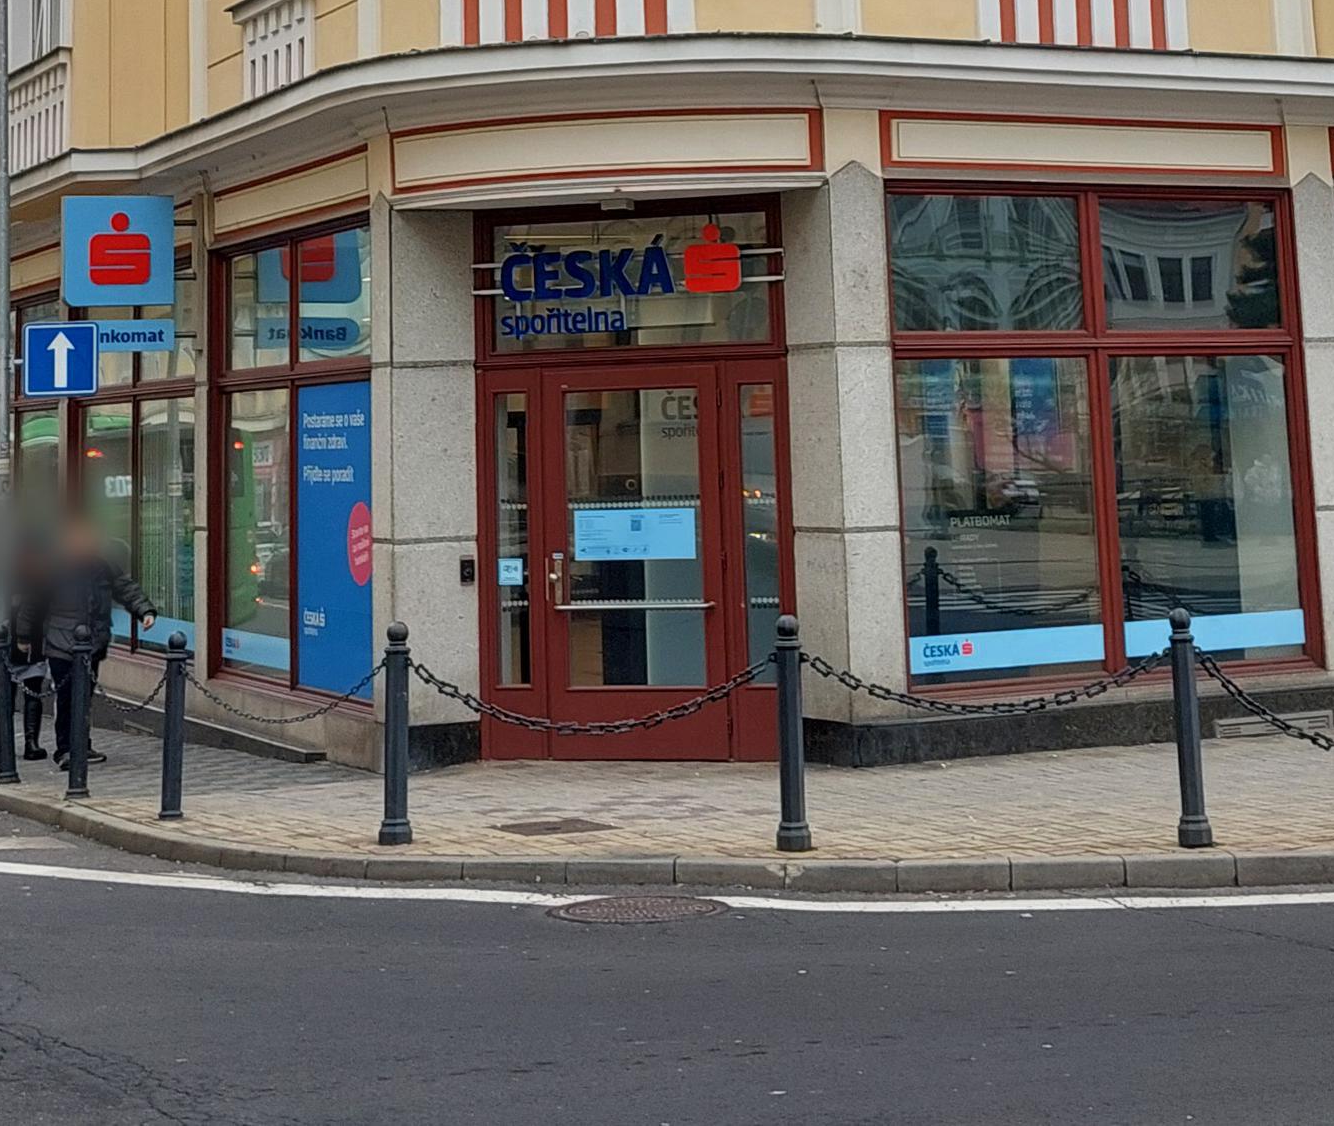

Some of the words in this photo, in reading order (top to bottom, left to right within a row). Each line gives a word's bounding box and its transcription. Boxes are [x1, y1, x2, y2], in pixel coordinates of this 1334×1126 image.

[500, 234, 675, 302] ČESKÁ
[501, 306, 628, 340] spořitelna
[100, 330, 165, 344] nkomat
[950, 515, 1011, 528] PLATBOMAT
[923, 641, 960, 658] ČESKÁ
